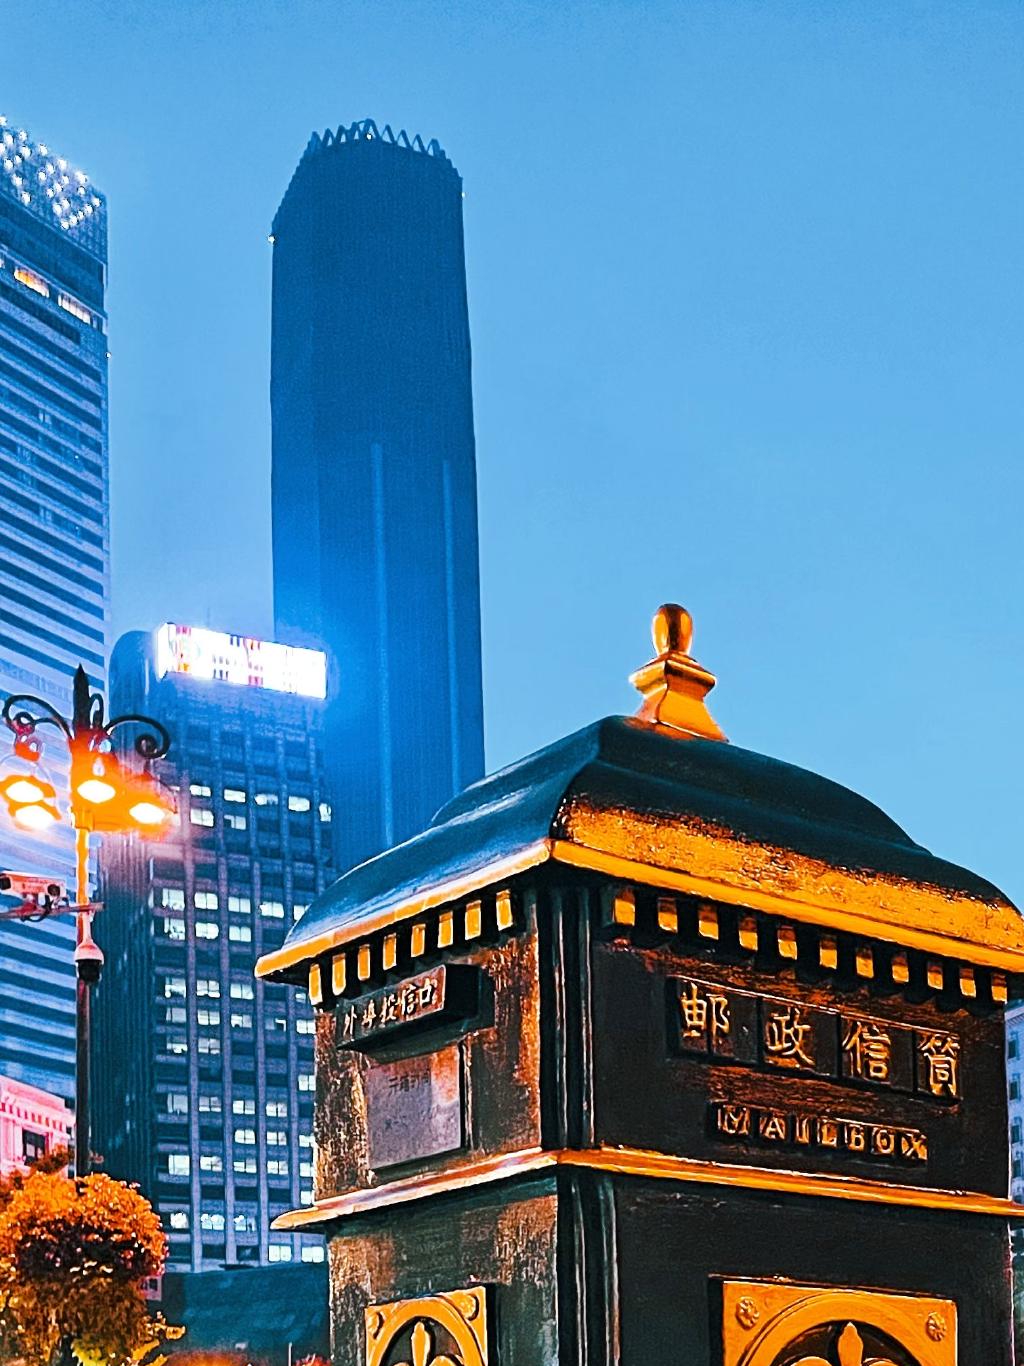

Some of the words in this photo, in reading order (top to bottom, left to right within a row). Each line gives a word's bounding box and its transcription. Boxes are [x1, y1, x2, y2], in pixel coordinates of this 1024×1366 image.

[680, 981, 961, 1097] 邮政信筒
[716, 1104, 928, 1161] MAILBOX
